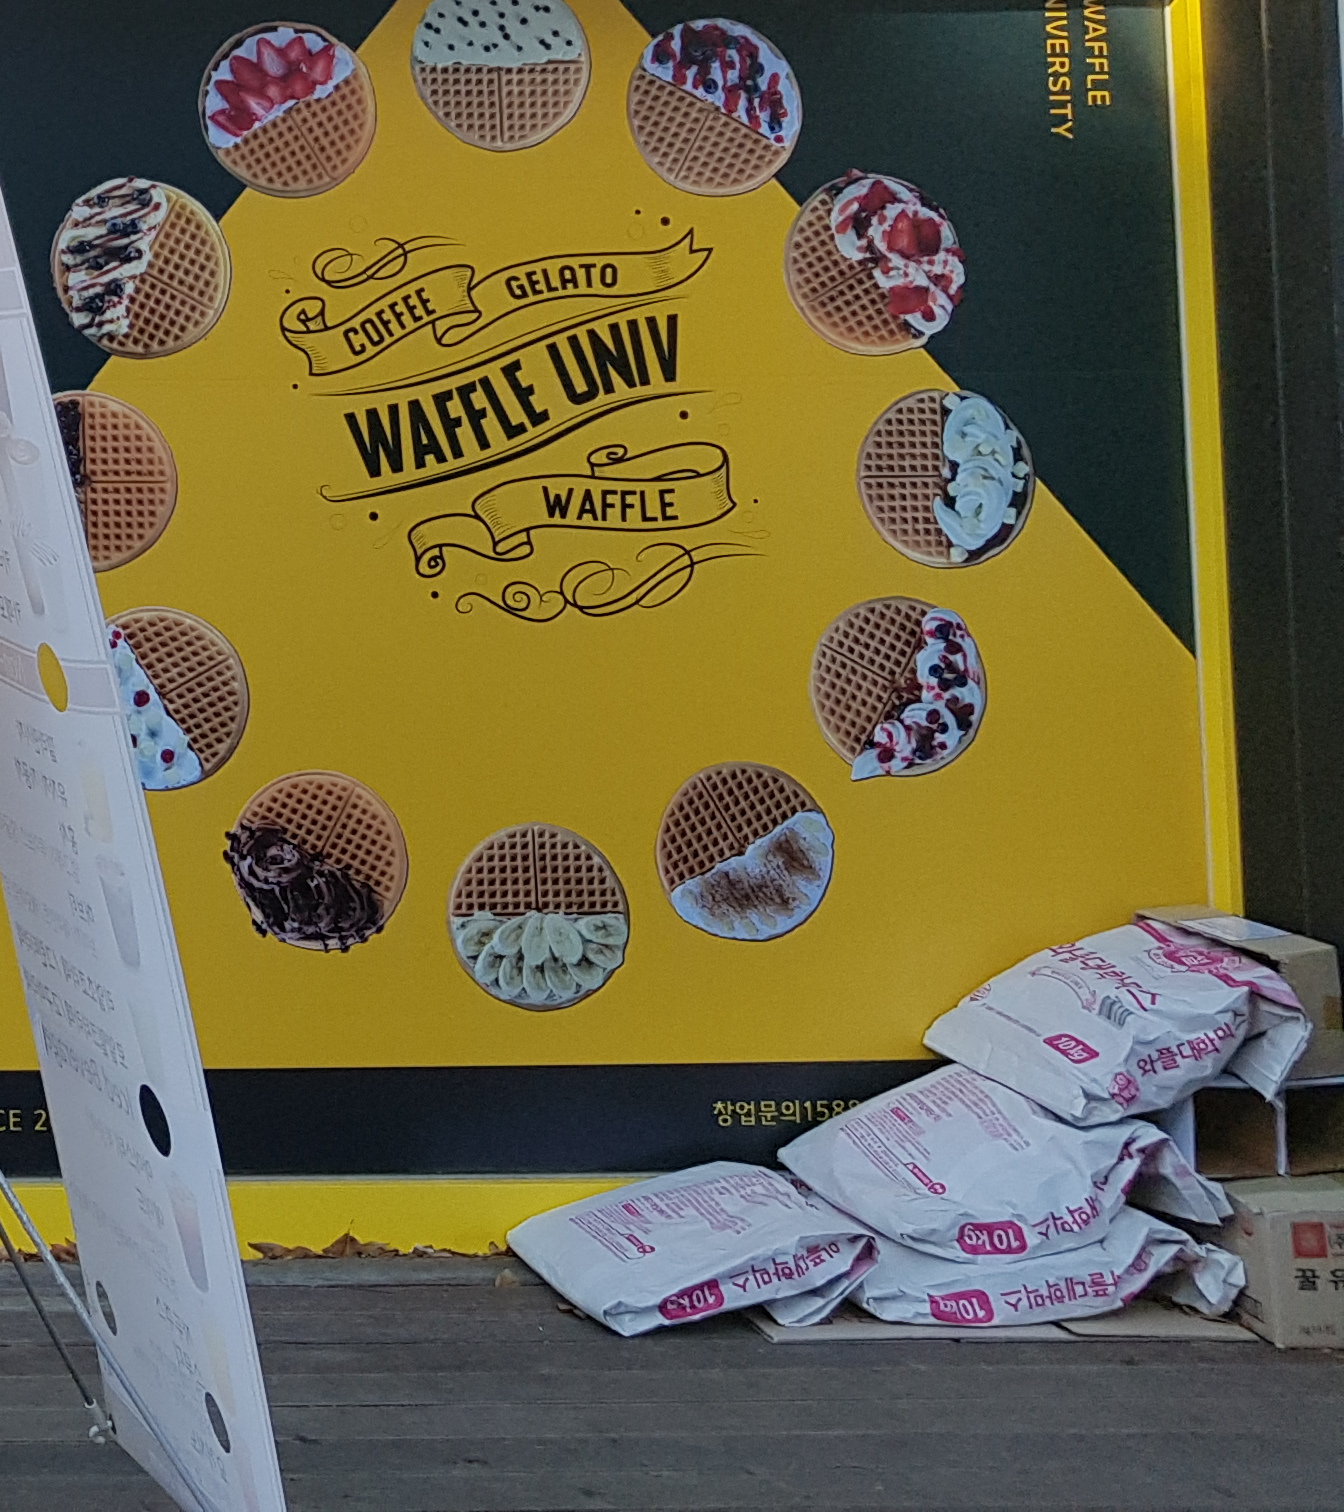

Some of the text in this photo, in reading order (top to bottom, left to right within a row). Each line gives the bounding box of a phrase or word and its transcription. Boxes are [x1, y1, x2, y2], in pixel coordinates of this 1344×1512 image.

[504, 262, 619, 300] GELATO
[343, 287, 437, 357] COFFEE
[344, 313, 679, 478] WAFFLE UNIV
[541, 486, 680, 522] WAFFLE
